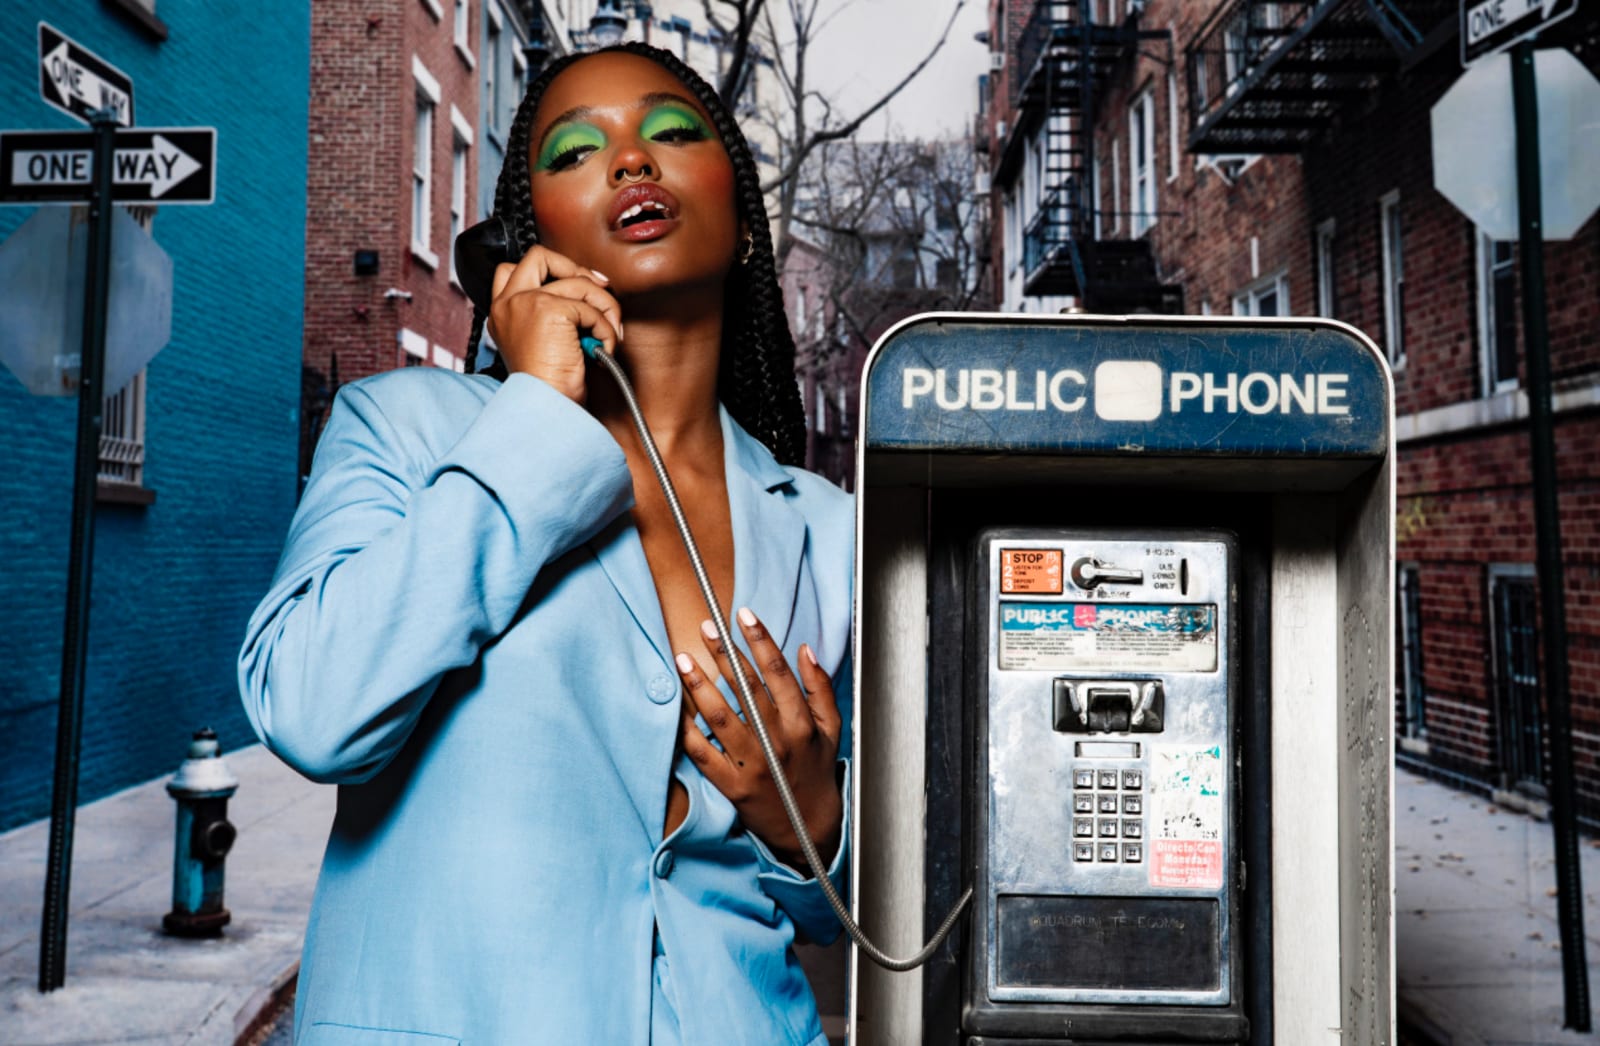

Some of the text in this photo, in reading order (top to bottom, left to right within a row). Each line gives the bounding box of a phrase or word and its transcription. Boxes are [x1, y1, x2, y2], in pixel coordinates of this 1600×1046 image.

[1472, 0, 1506, 37] ONE
[51, 56, 126, 119] ONE WAY
[28, 153, 180, 181] ONE WAY
[902, 368, 1350, 416] PUBLIC PHONE
[1013, 553, 1044, 564] STOP
